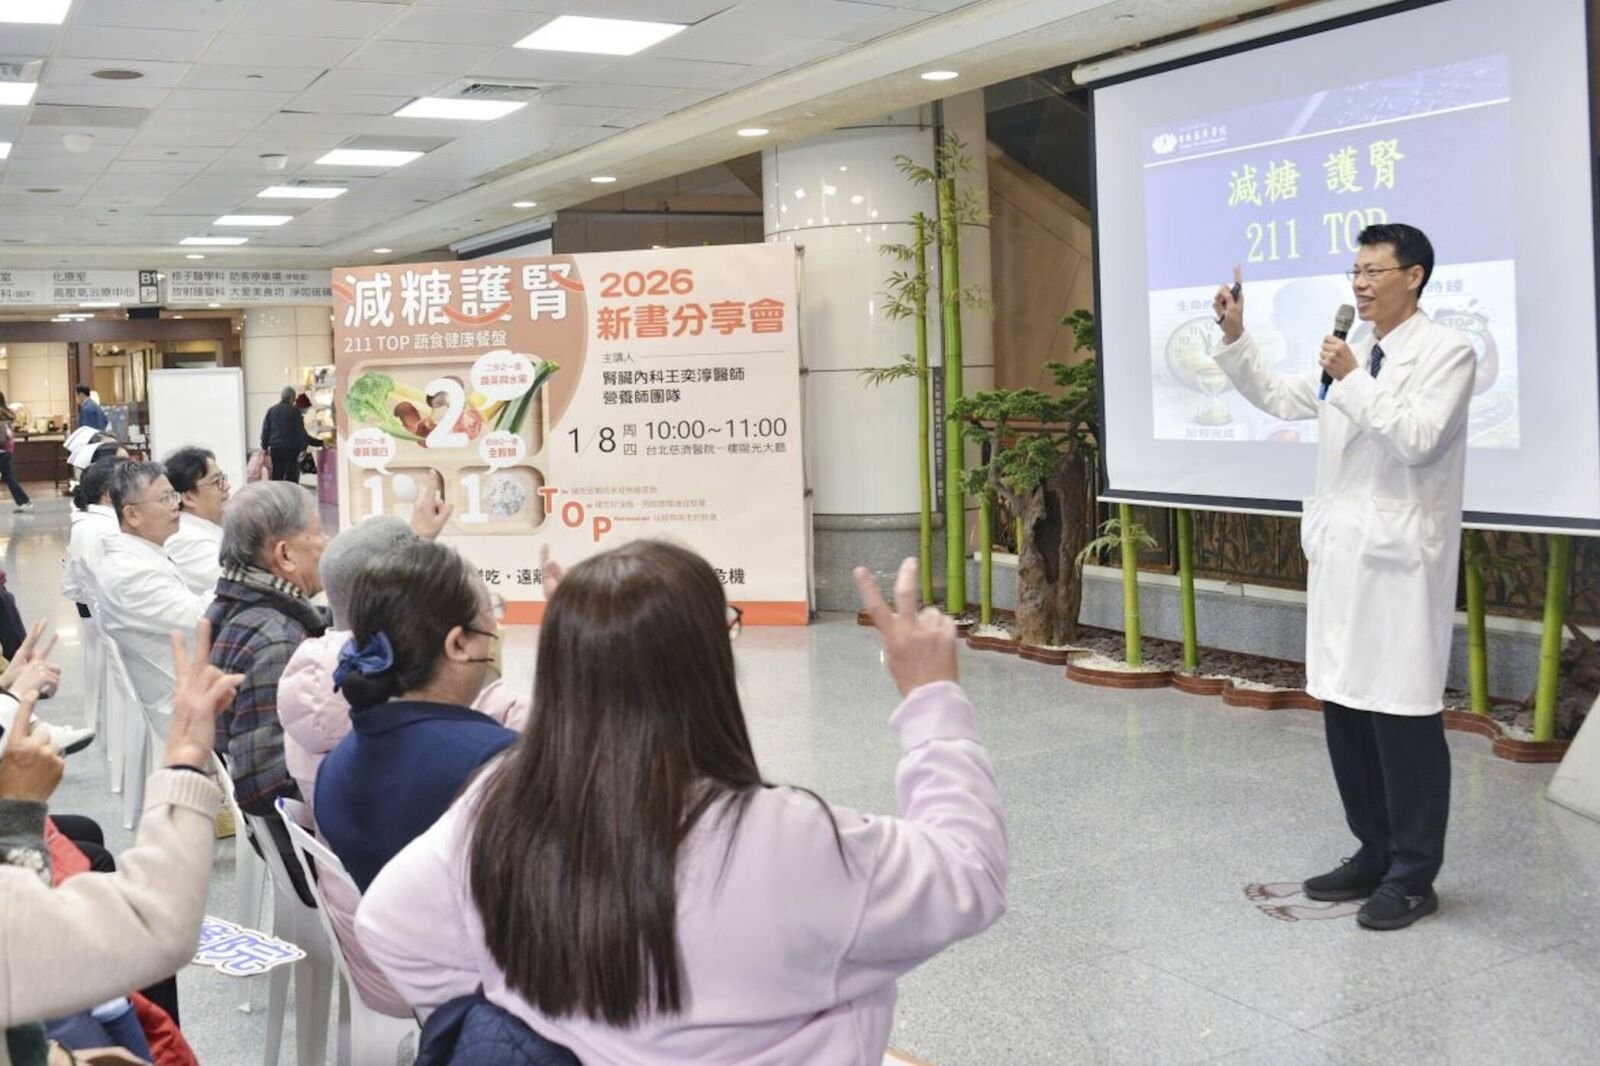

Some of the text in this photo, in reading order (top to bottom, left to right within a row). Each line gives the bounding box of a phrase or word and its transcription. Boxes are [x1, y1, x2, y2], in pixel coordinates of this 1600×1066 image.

[1227, 138, 1405, 207] 減糖 護腎
[1246, 218, 1299, 262] 211
[140, 272, 157, 284] B1
[600, 269, 694, 298] 2026
[344, 264, 571, 328] 減糖護腎
[597, 298, 785, 340] 新書分享會
[345, 330, 507, 352] 211 TOP 蔬食健康餐盤
[602, 353, 634, 363] 主講人
[603, 367, 745, 386] 腎臟內科王奕淳醫師
[603, 389, 681, 405] 營養師團隊
[425, 376, 469, 448] 2
[645, 418, 787, 440] 10:00~11:00
[460, 474, 490, 523] 1
[539, 488, 559, 514] T
[561, 500, 586, 529] O
[592, 515, 613, 543] P
